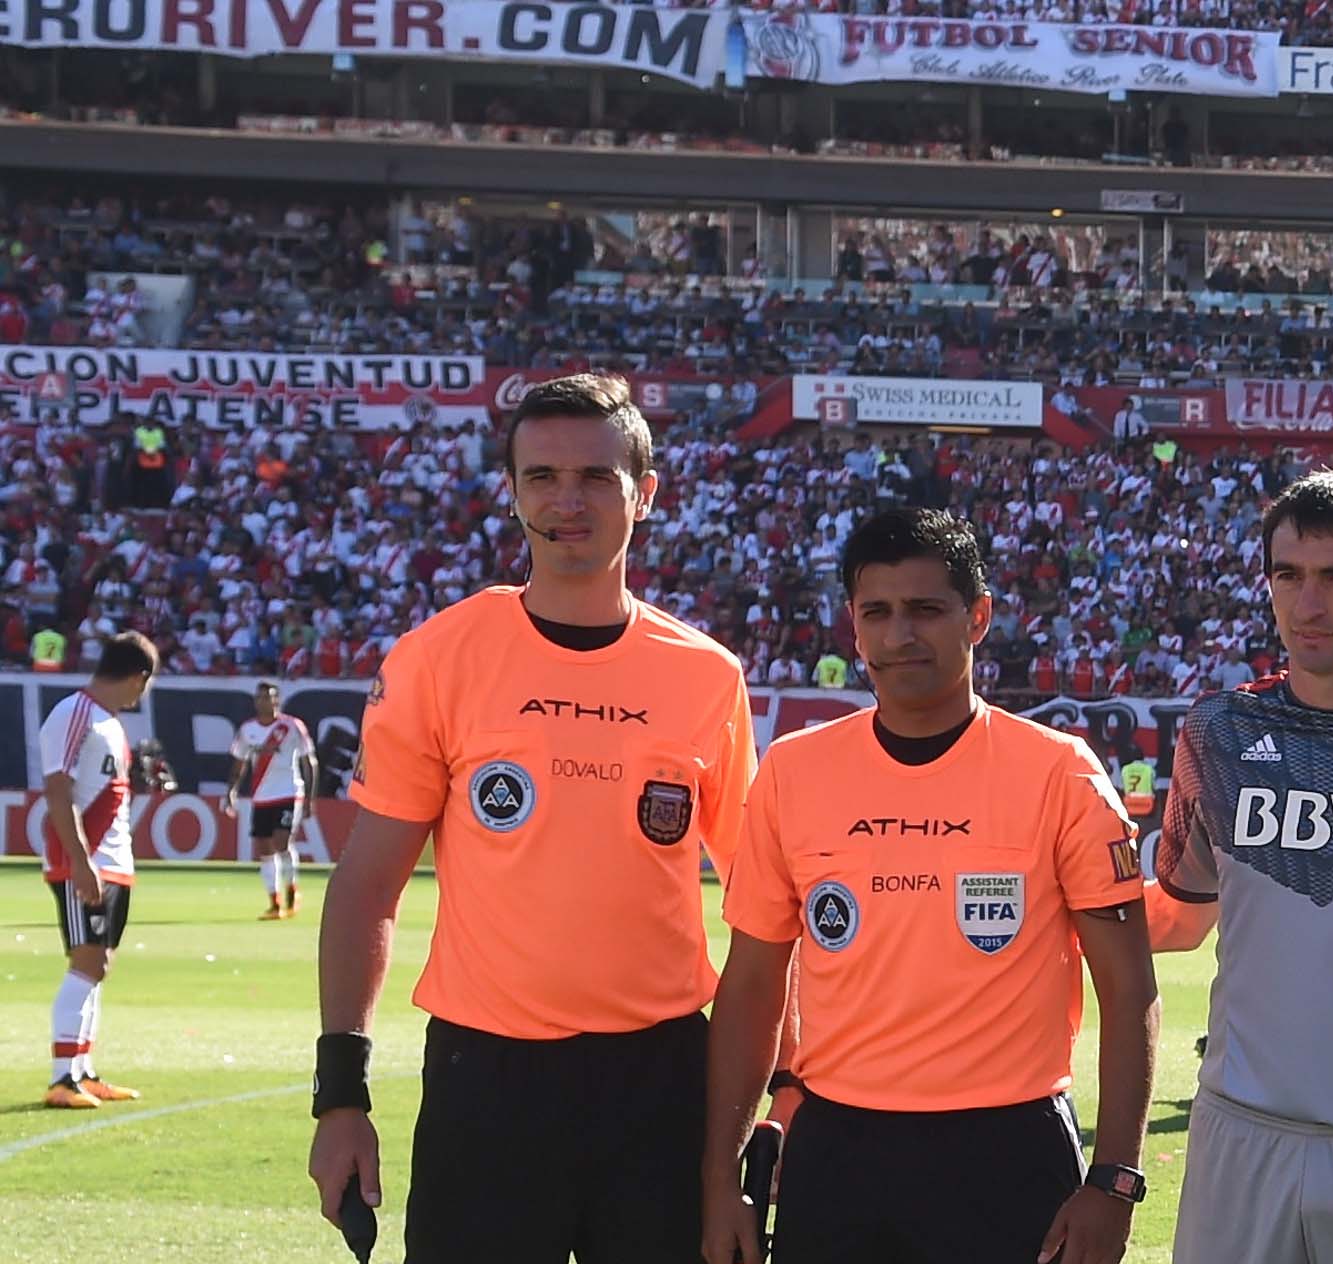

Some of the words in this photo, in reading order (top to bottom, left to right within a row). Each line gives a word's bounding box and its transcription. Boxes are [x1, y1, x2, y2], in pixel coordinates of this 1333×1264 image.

[0, 0, 711, 77] RORIVER.COM
[842, 17, 1039, 65] FUTBOL
[1071, 28, 1257, 82] SENIOR
[169, 356, 472, 391] JUVENTUD
[919, 386, 1022, 409] MEDICAL
[520, 699, 649, 725] ATHIX
[1240, 751, 1282, 762] adidas
[551, 758, 624, 781] DOVALO
[847, 818, 971, 837] ATHIX
[871, 874, 941, 894] BONFA
[961, 877, 1018, 887] ASSISTANT
[965, 887, 1015, 897] REFEREE
[964, 902, 1016, 921] FIFA
